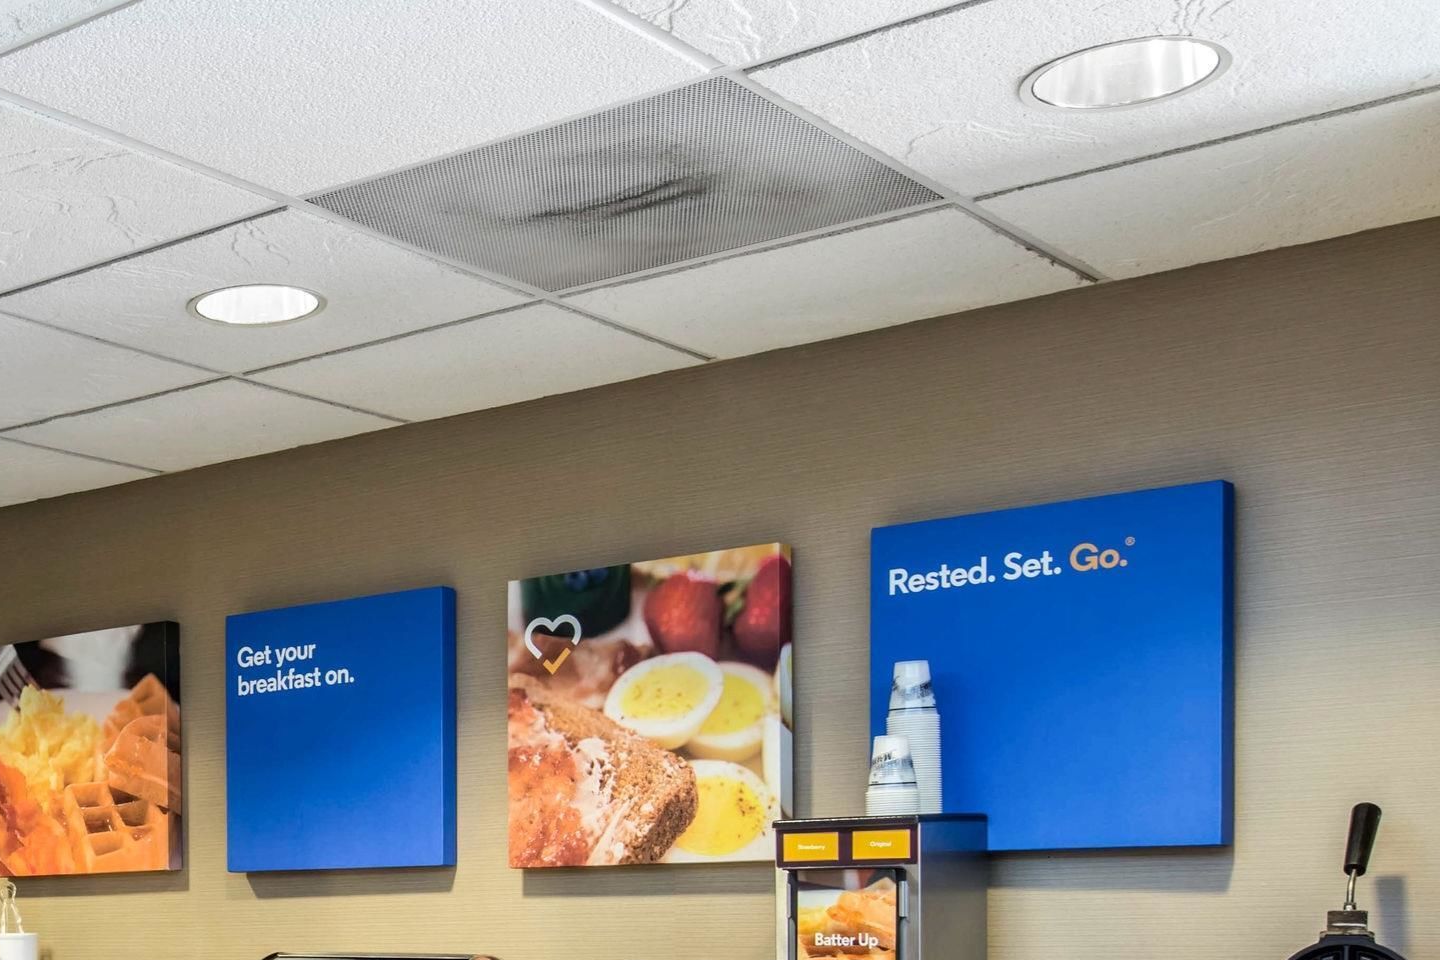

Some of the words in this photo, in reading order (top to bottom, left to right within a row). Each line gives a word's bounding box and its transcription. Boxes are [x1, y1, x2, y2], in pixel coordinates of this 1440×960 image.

[888, 556, 996, 596] Rested.
[1002, 550, 1062, 580] Set.
[237, 645, 272, 668] Get
[274, 643, 317, 668] your
[237, 667, 322, 696] breakfast
[324, 668, 355, 686] on.
[814, 932, 857, 947] Batter
[858, 932, 879, 949] Up
